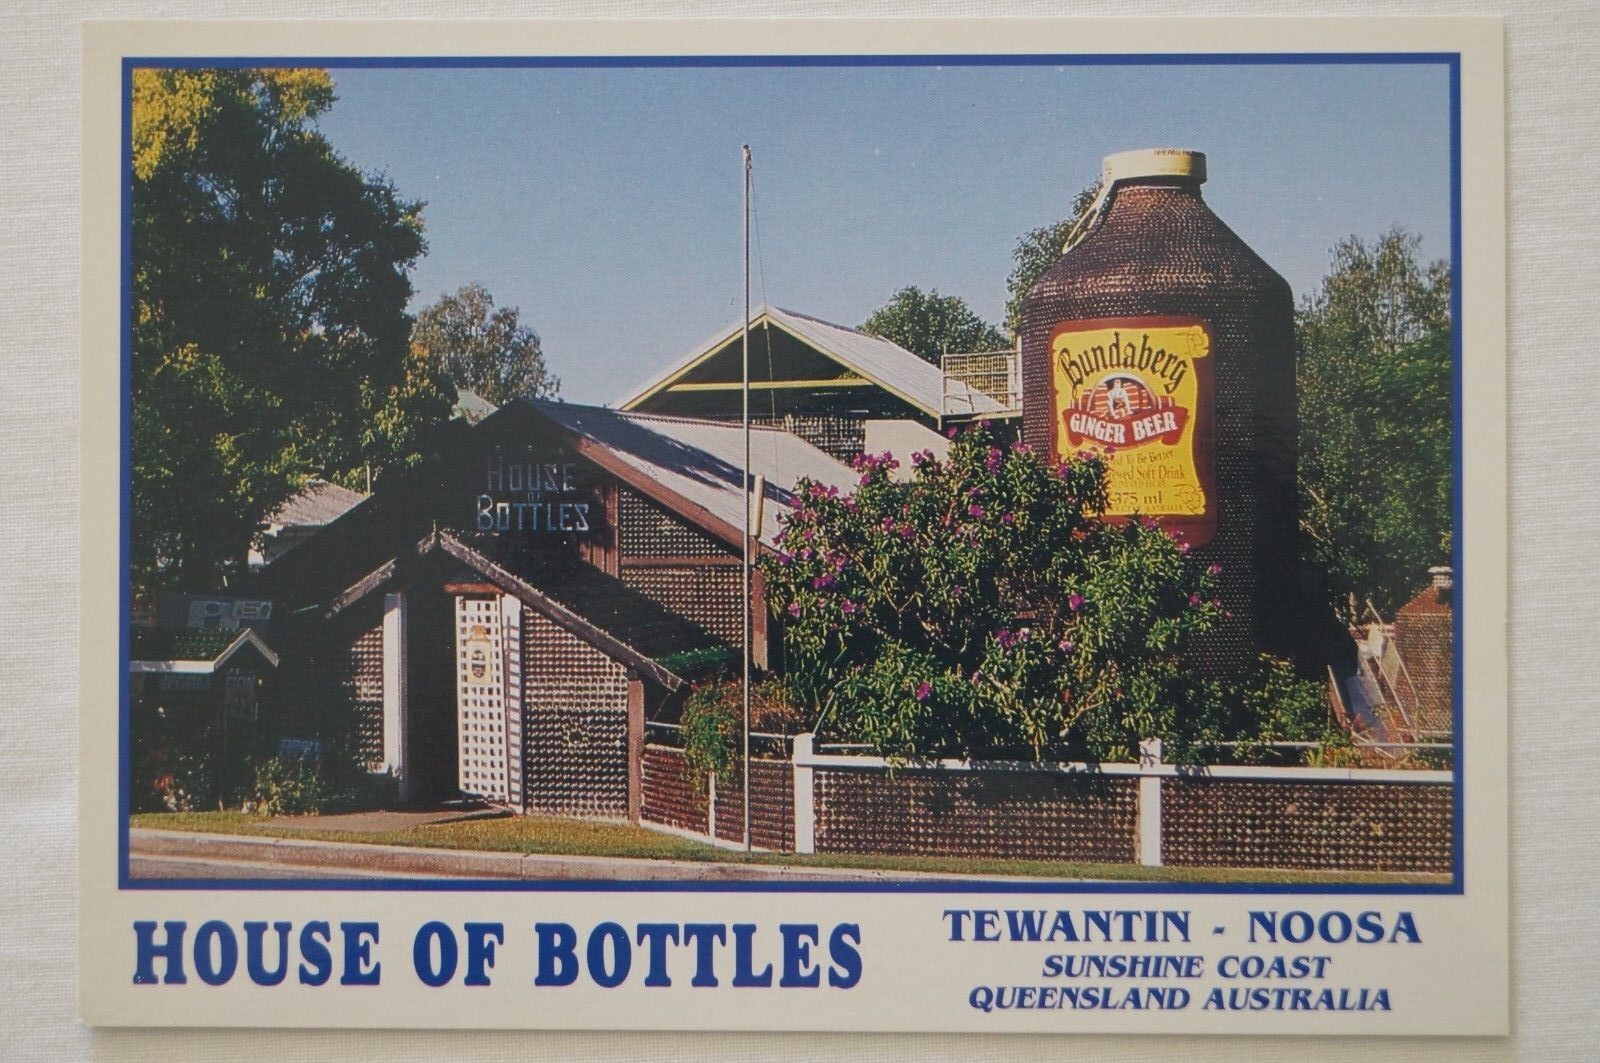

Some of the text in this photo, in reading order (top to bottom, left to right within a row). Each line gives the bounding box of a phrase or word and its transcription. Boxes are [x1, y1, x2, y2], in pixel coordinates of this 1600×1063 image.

[1057, 331, 1188, 399] Bundaberg
[1069, 411, 1178, 444] GINGER BEER
[487, 456, 577, 491] HOUSE
[1136, 453, 1147, 464] Be
[1136, 465, 1156, 480] Soft
[1158, 464, 1185, 480] Drink
[477, 494, 589, 531] BOTTLES
[1143, 490, 1163, 504] ml
[943, 909, 1191, 943] TEWANTIN
[1248, 911, 1423, 944] NOOSA
[133, 920, 863, 989] HOUSE OF BOTTLES
[1042, 955, 1332, 979] SUNSHINE COAST
[968, 986, 1392, 1013] QUEENSLAND AUSTRALIA
